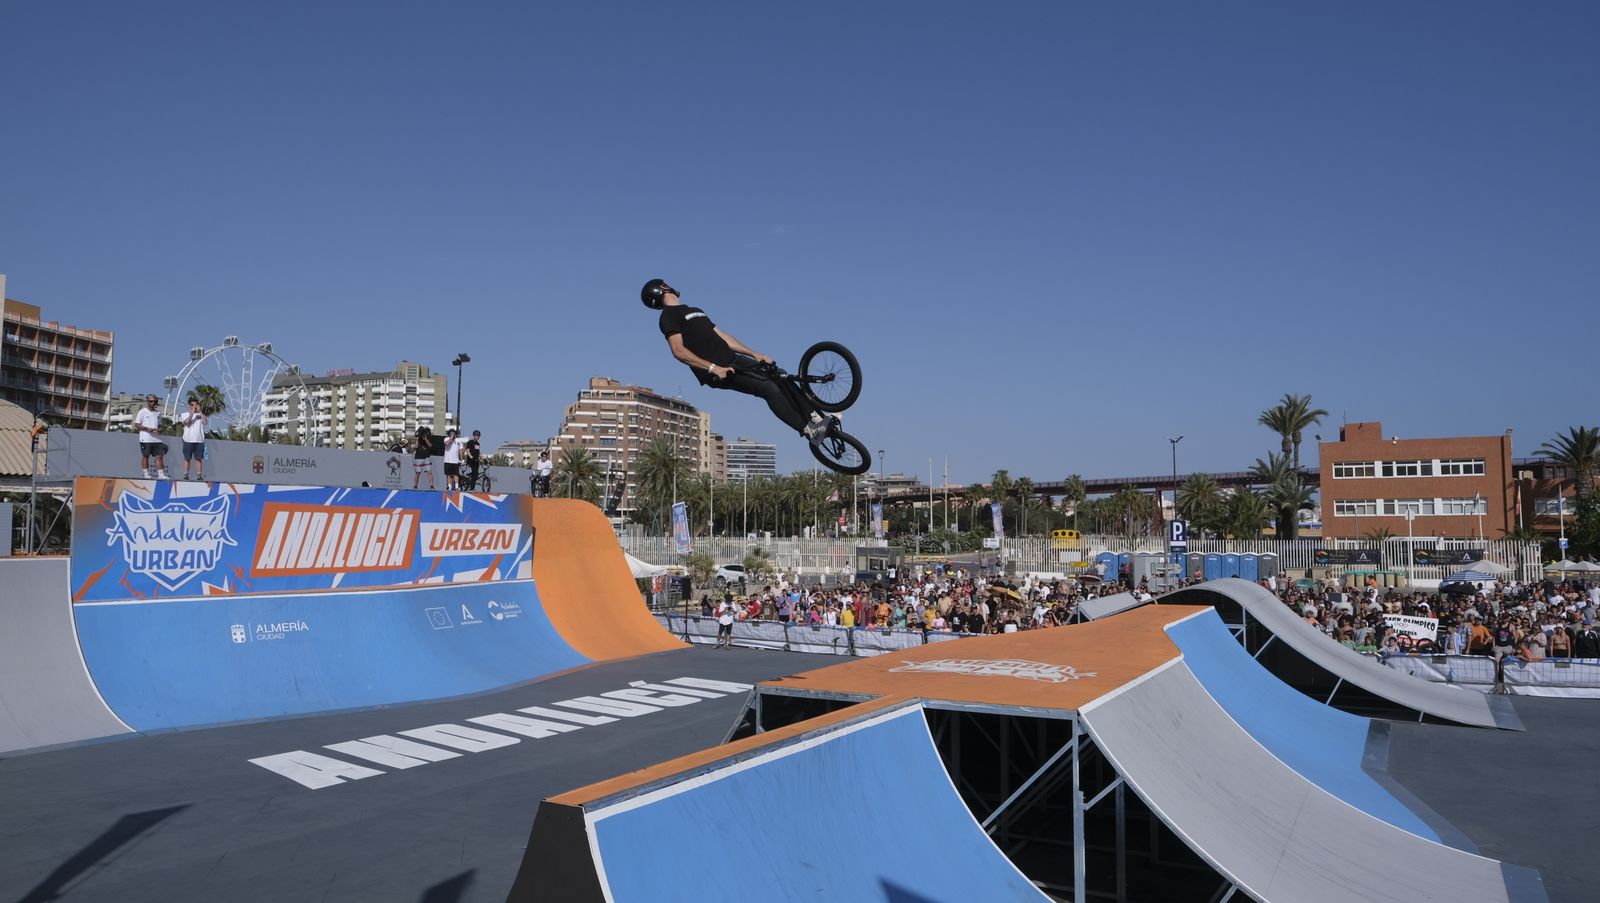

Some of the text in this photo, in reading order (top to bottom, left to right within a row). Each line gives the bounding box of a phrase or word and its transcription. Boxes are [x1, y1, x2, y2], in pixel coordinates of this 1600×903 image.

[273, 457, 317, 468] ALMERÍA
[256, 507, 413, 570] ANDALUCÍA
[429, 527, 515, 551] URBAN
[132, 549, 214, 570] URBAN
[256, 620, 309, 633] ALMERÍA
[247, 677, 756, 790] ANDALUCÍA
